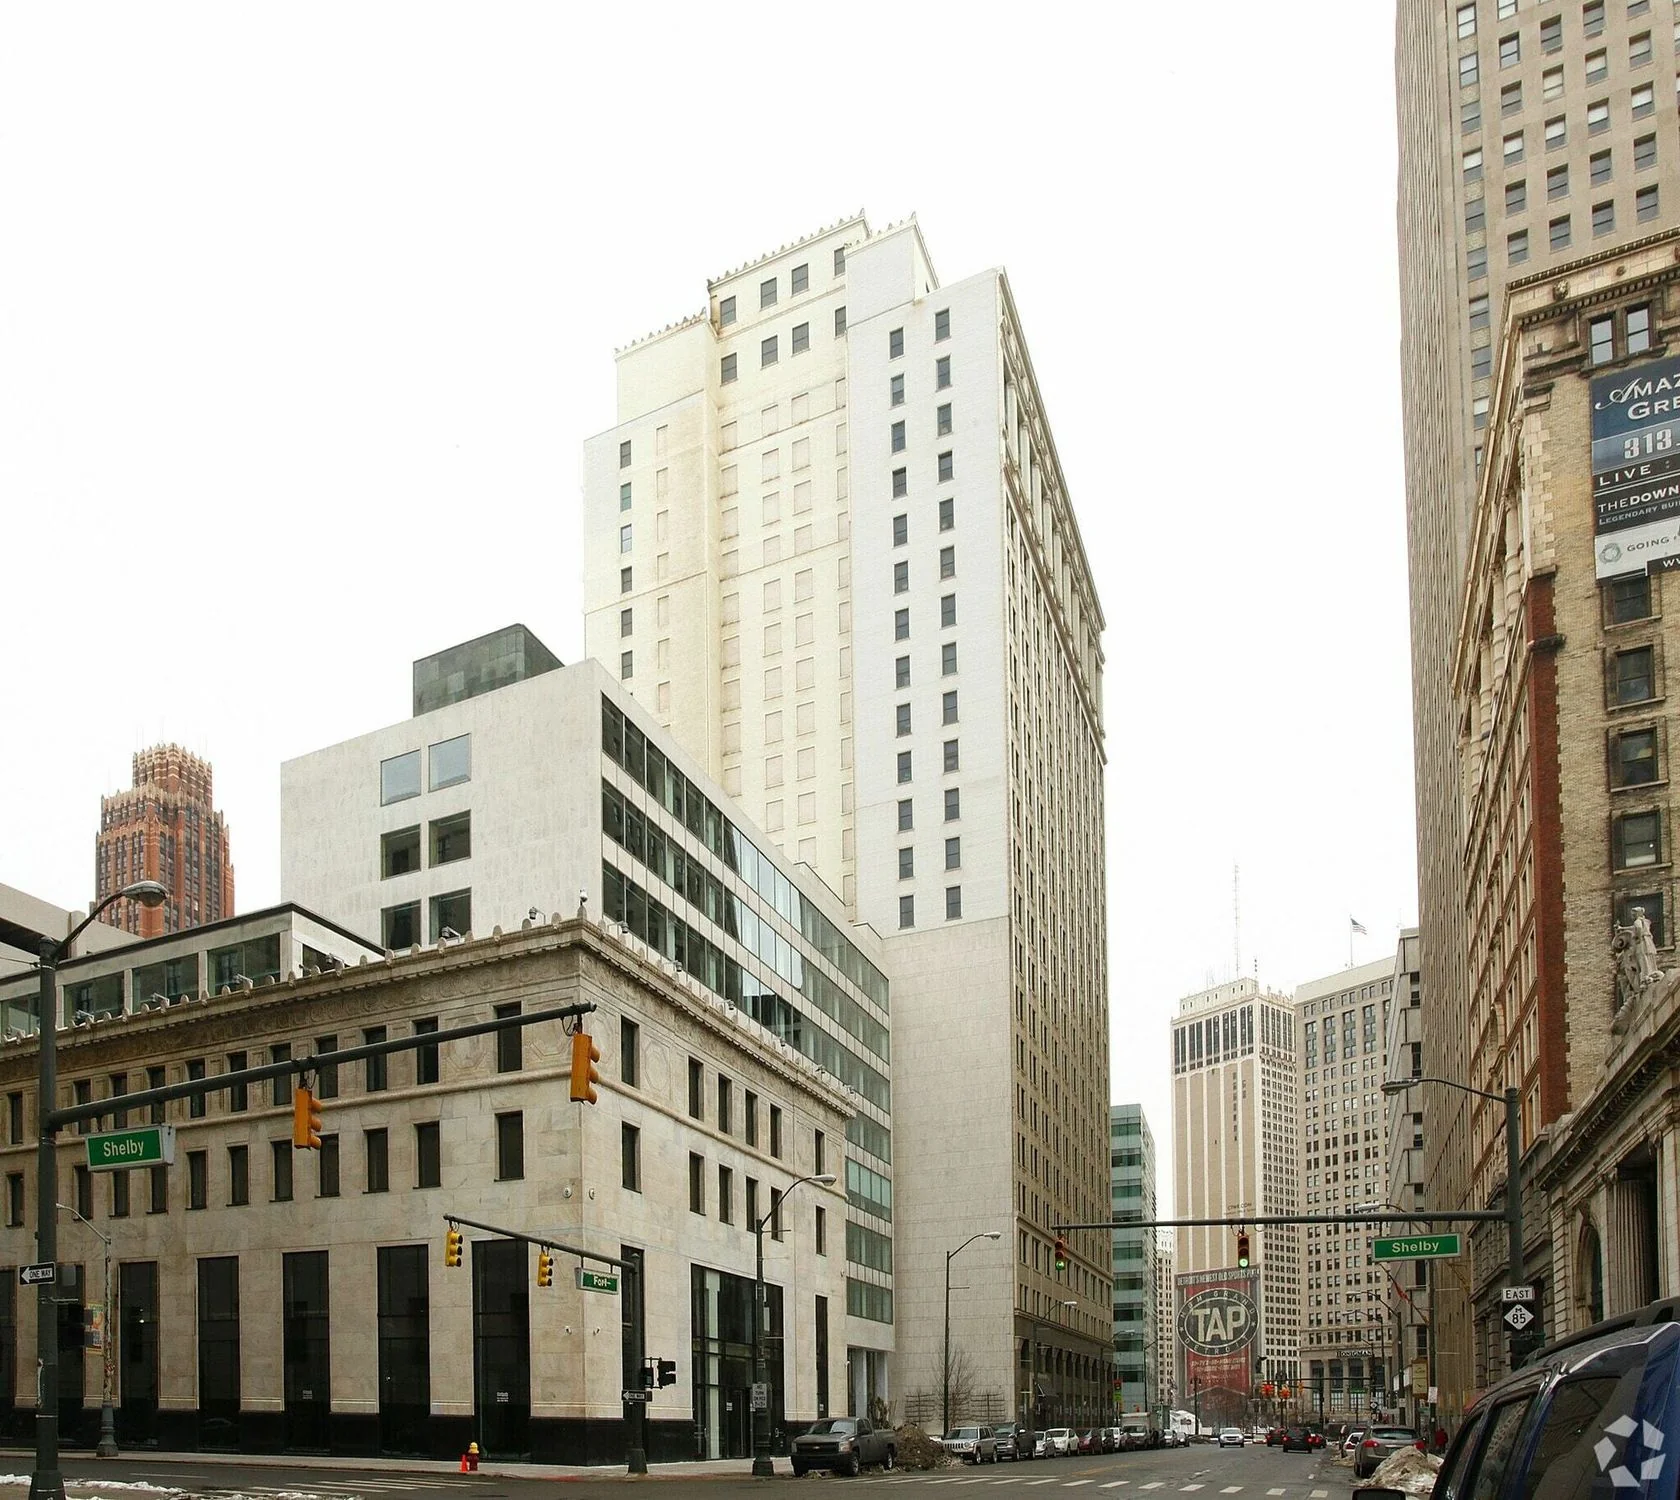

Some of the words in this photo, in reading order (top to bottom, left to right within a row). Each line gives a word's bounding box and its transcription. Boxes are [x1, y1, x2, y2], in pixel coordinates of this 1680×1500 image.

[1599, 464, 1651, 487] LIVE
[1599, 506, 1658, 526] LEGENDARY
[1661, 500, 1680, 510] BUI
[1627, 536, 1670, 552] GOING
[103, 1140, 144, 1157] Shelby
[1391, 1240, 1439, 1254] Shelby
[29, 1270, 40, 1279] ONE
[41, 1269, 52, 1278] WAY
[1213, 1290, 1256, 1315] GRAND
[1505, 1289, 1530, 1299] EAST
[1191, 1305, 1247, 1343] TAP
[1512, 1313, 1526, 1324] 85
[1184, 1335, 1249, 1355] DETROIT
